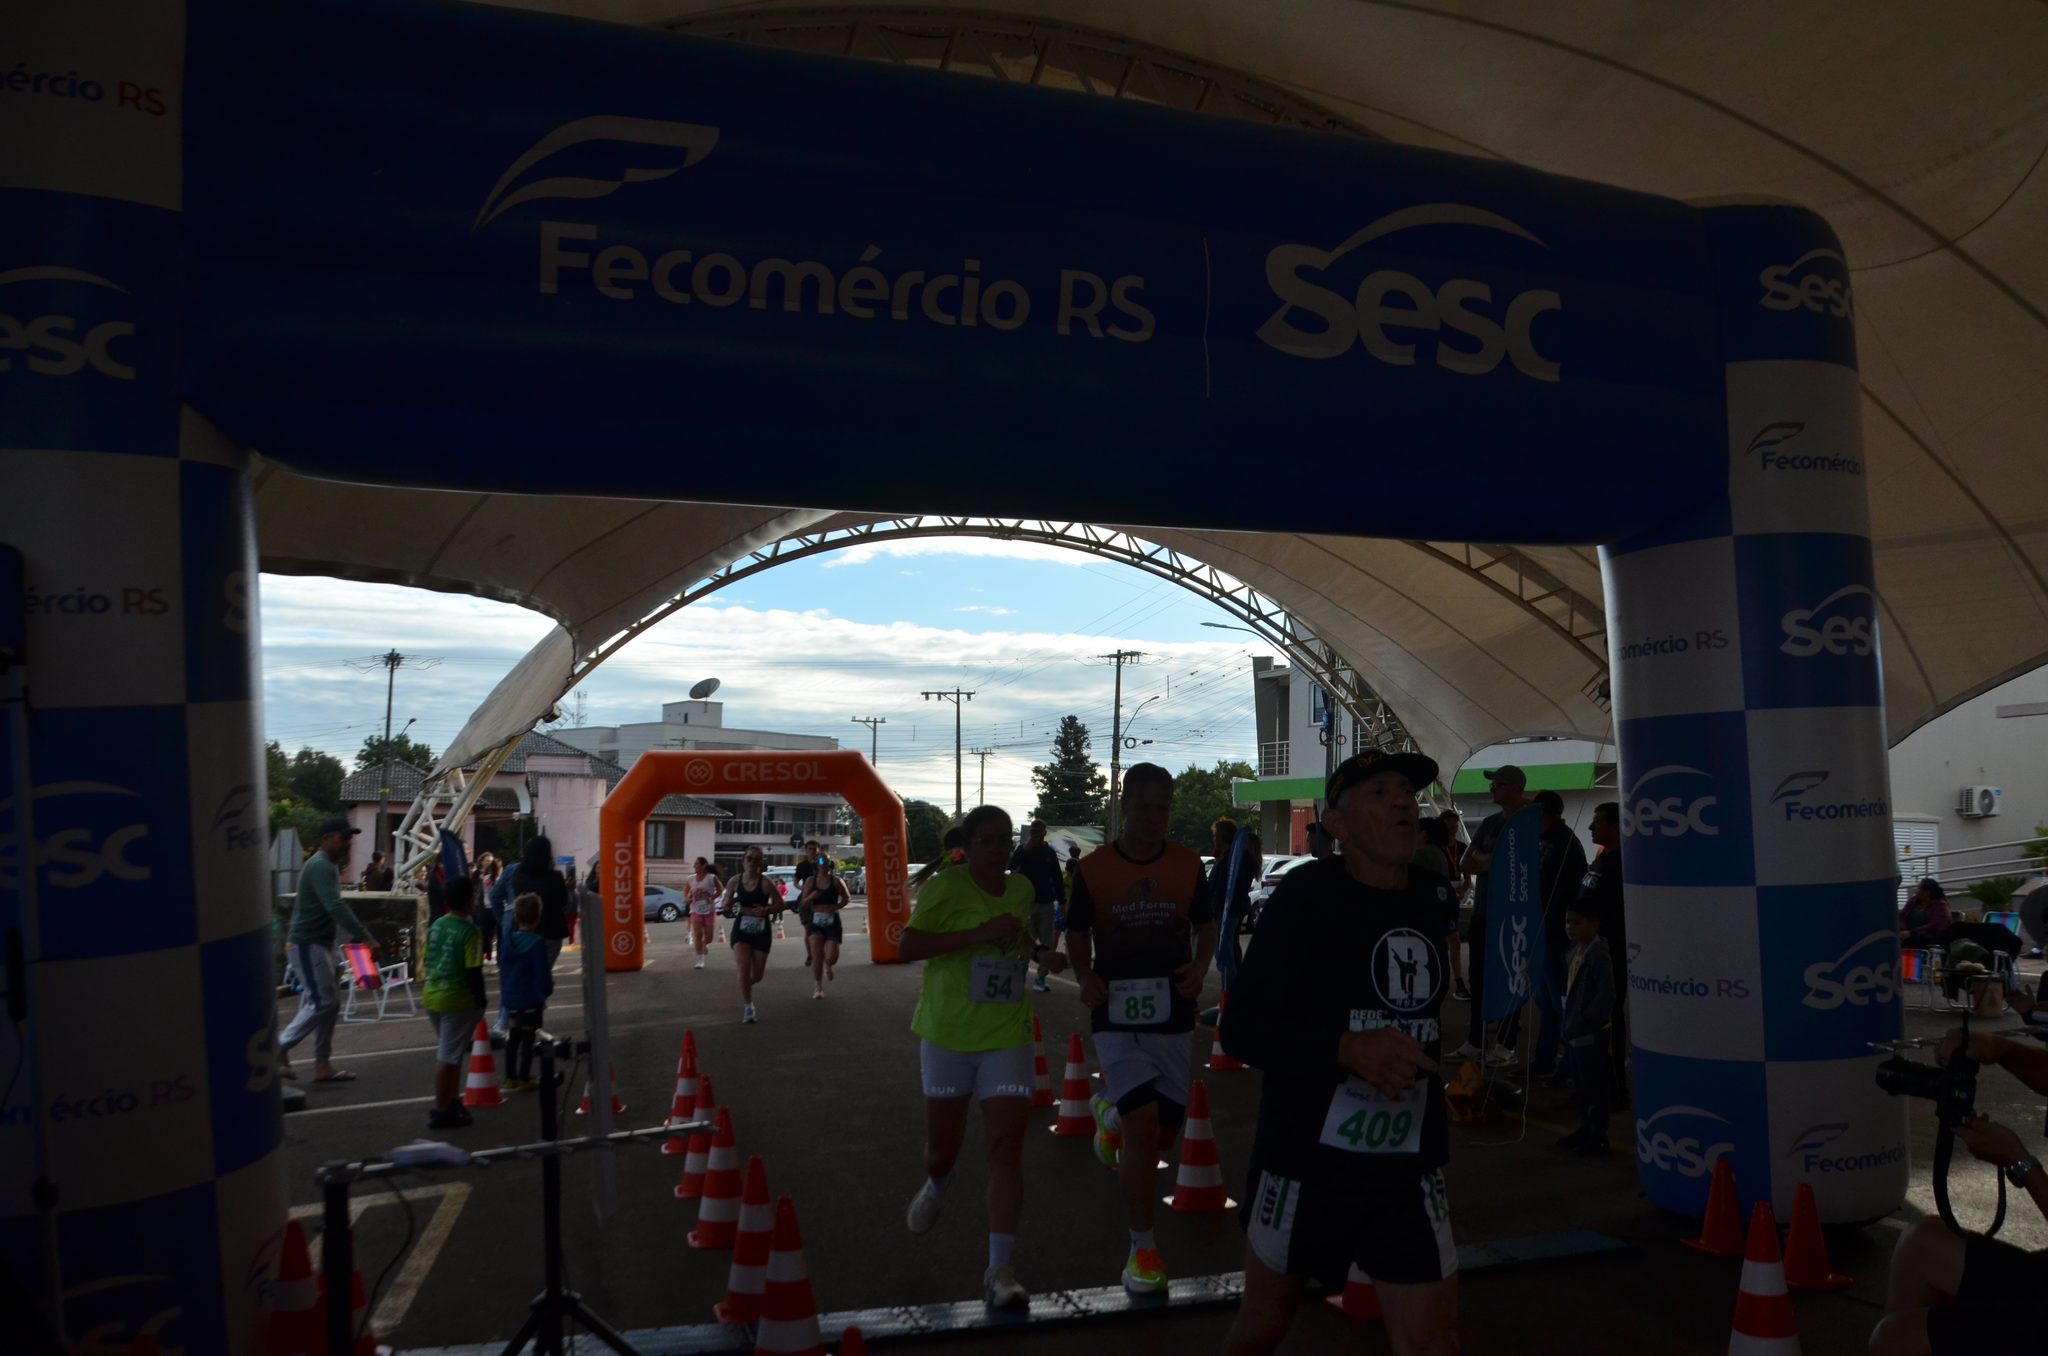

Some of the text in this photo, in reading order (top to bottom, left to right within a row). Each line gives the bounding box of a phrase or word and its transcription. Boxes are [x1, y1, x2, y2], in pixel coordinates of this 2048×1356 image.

[118, 80, 166, 117] RS
[538, 219, 1157, 344] Fecomércio RS
[1256, 242, 1562, 383] Sesc
[1761, 451, 1861, 476] Fecomércio
[123, 587, 169, 616] RS
[1695, 629, 1729, 651] RS
[1779, 608, 1875, 657] Ses
[723, 760, 827, 783] CRESOL
[1785, 797, 1888, 823] Fecomércio
[614, 834, 633, 925] CRESOL
[884, 826, 899, 915] CRESOL
[1139, 899, 1177, 911] Forma
[986, 974, 1012, 999] 54
[1628, 973, 1751, 999] ecomércio RS
[1125, 995, 1156, 1020] 85
[1350, 1009, 1384, 1019] REDE
[149, 1075, 194, 1107] RS
[1337, 1109, 1412, 1149] 409
